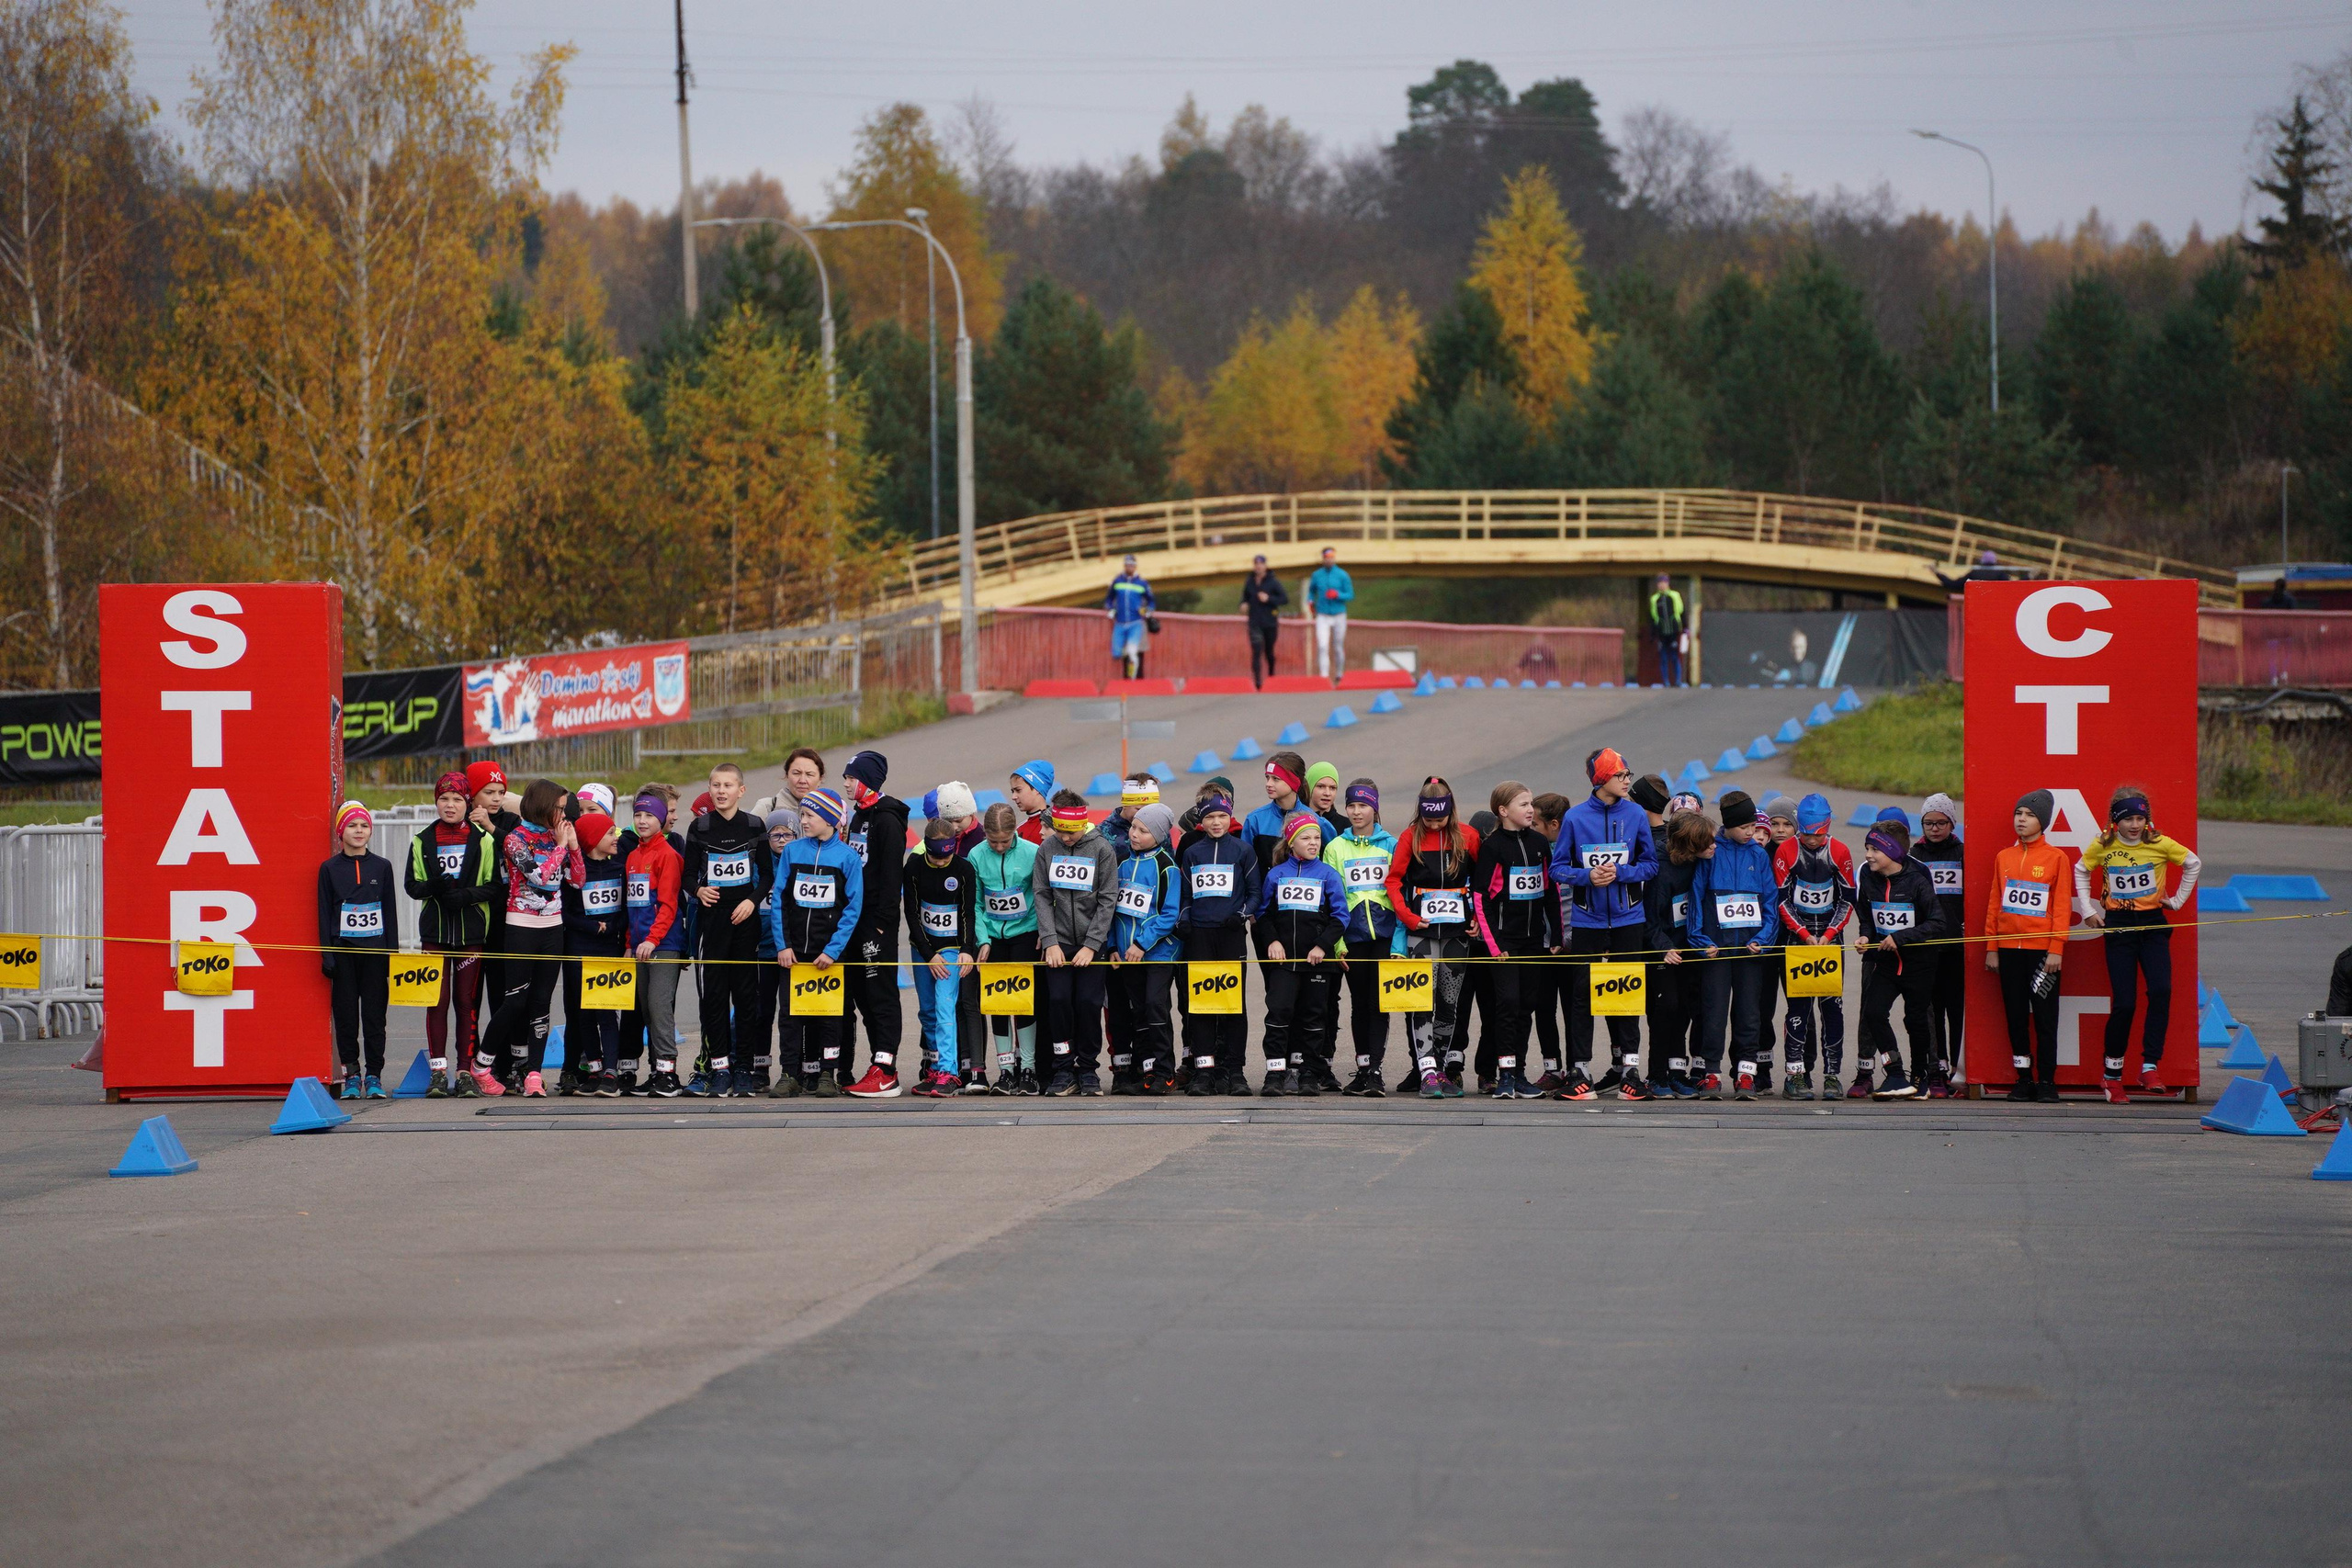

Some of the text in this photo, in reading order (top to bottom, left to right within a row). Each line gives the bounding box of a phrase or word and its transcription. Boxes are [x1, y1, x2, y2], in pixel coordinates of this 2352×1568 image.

[540, 661, 641, 698] Demino ski
[343, 696, 438, 739] ERUP
[552, 698, 632, 729] marathon
[2, 720, 101, 761] POWE
[157, 590, 264, 1067] START
[1589, 853, 1623, 868] 627
[2103, 851, 2130, 867] ОЛОТОЕ
[713, 863, 745, 877] 646
[1056, 864, 1089, 880] 630
[1351, 866, 1384, 882] 619
[1934, 871, 1957, 884] 52
[1196, 874, 1227, 888] 633
[1516, 876, 1542, 890] 639
[2115, 874, 2150, 889] 618
[589, 888, 618, 905] 659
[799, 883, 830, 898] 647
[1117, 889, 1146, 908] 616
[1282, 886, 1315, 901] 626
[1800, 889, 1831, 905] 637
[2008, 890, 2041, 907] 605
[989, 897, 1020, 911] 629
[1427, 900, 1459, 914] 622
[1724, 903, 1755, 918] 649
[346, 912, 378, 928] 635
[923, 911, 952, 927] 648
[1876, 911, 1909, 926] 634
[0, 947, 38, 967] OKO
[181, 954, 230, 976] TOKO
[393, 966, 439, 987] TOKO
[1790, 957, 1838, 980] TOKO
[585, 969, 632, 990] TOKO
[794, 975, 841, 997] TOKO
[984, 975, 1031, 997] TOKO
[1192, 973, 1238, 995] TOKO
[1383, 971, 1429, 994] TOKO
[1594, 975, 1642, 997] TOKO
